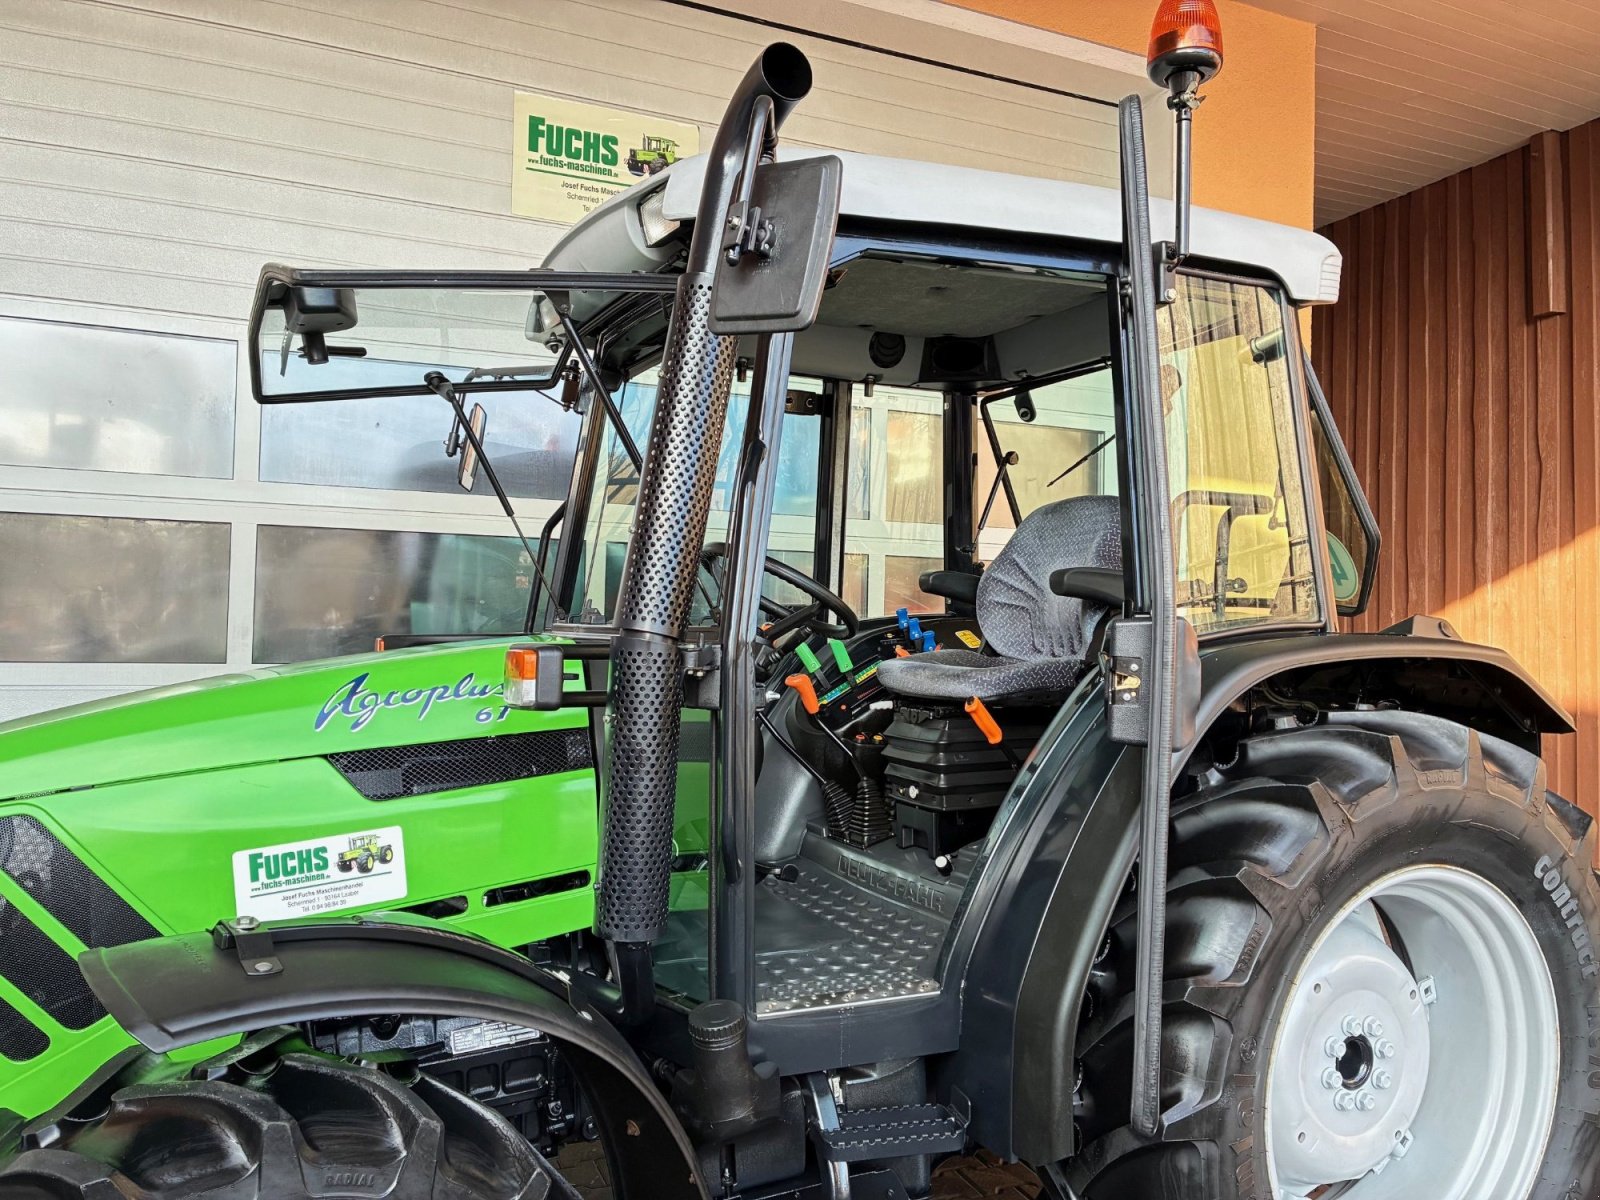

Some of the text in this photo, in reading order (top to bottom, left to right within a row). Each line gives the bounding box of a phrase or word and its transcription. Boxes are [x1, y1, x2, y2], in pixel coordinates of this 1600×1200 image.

[528, 115, 618, 166] FUCHS
[528, 155, 619, 178] www.fuchs-maschinen.de
[561, 181, 579, 190] Josef
[580, 184, 599, 193] Fuchs
[249, 846, 329, 883] FUCHS
[282, 894, 297, 902] Josef
